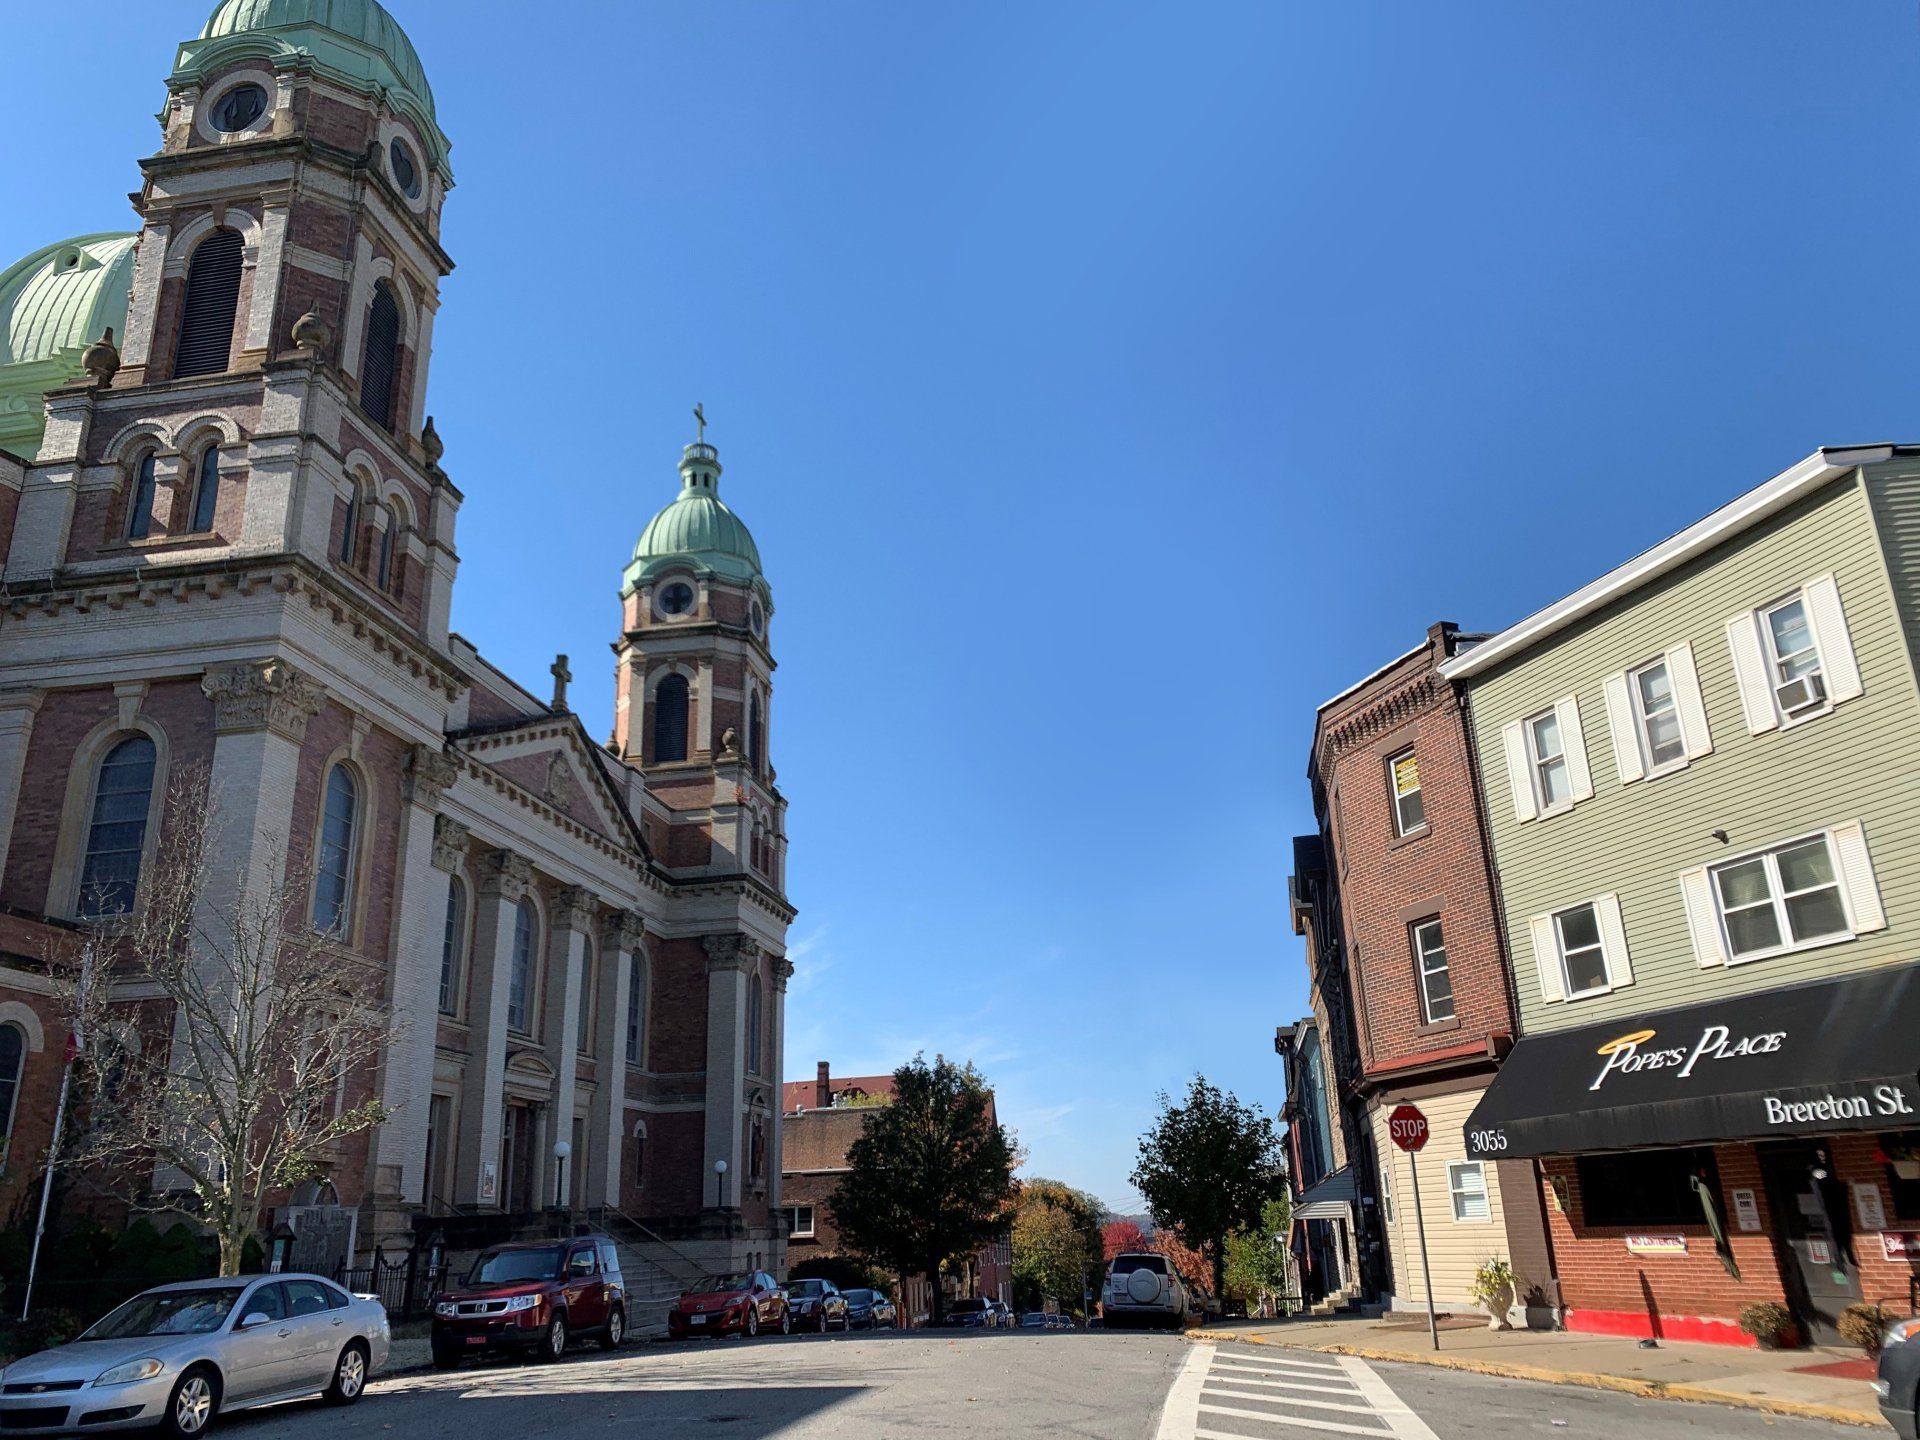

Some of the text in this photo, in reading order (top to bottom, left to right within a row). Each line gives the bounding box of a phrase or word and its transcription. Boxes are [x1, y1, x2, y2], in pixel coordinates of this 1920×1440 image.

[1589, 1025, 1787, 1090] POPE'S PLACE
[1764, 1085, 1913, 1124] Brereton St.
[1391, 1119, 1426, 1137] STOP
[1471, 1129, 1507, 1153] 3055
